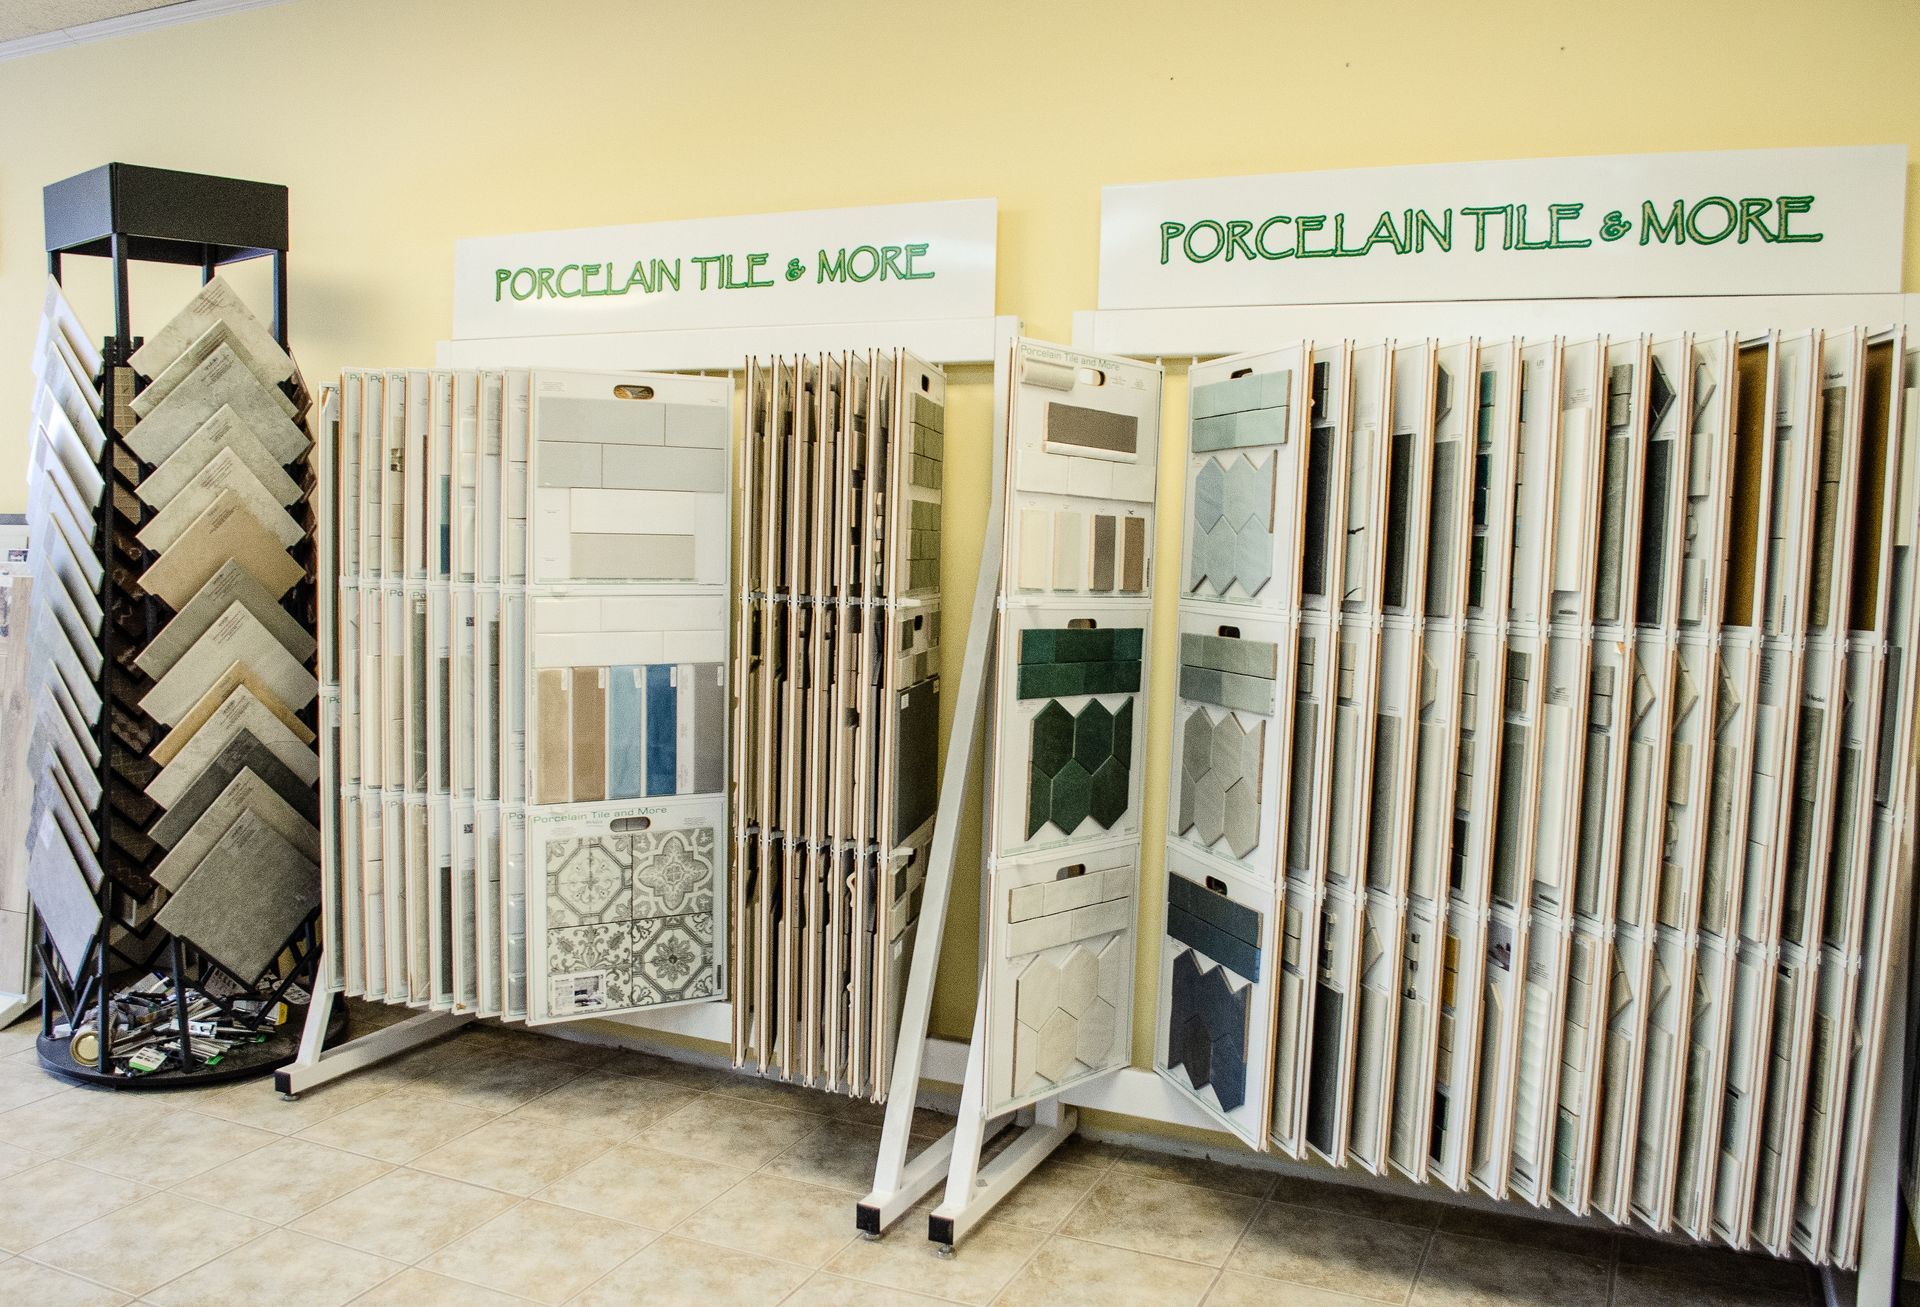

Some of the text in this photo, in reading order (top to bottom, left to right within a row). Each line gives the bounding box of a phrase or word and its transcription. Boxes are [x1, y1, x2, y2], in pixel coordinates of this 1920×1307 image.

[1160, 195, 1824, 265] PORCELAIN TILE & MORE
[495, 243, 936, 302] PORCELAIN TILE & MORE
[1020, 344, 1120, 371] Porcelain Tile and More
[533, 811, 588, 824] Porcelain
[592, 810, 611, 819] Tile
[614, 808, 634, 817] and
[638, 806, 667, 816] More
